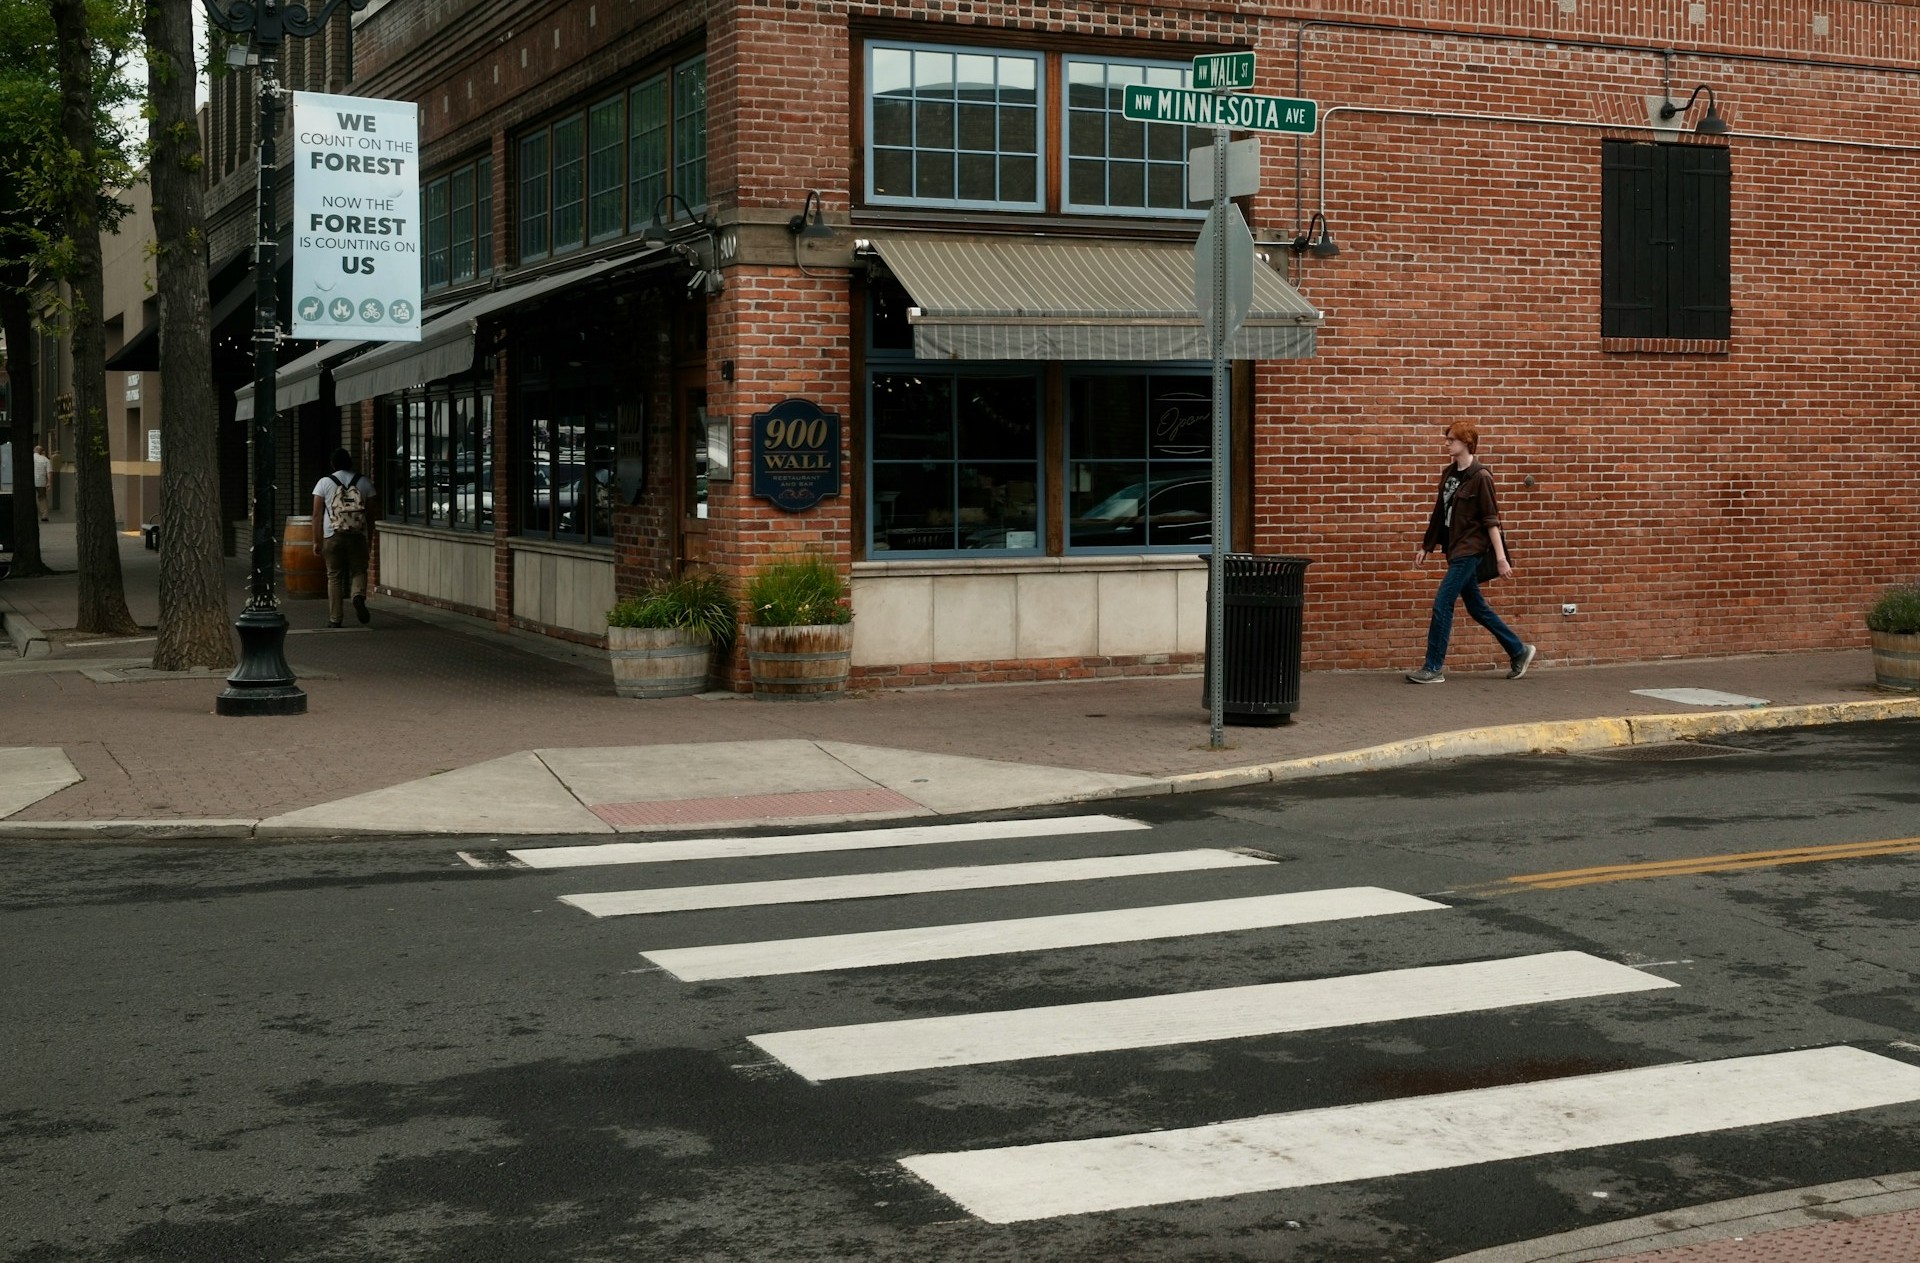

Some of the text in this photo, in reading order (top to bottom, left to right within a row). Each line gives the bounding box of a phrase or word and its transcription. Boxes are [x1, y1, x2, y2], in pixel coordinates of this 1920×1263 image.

[1198, 57, 1249, 86] NW WALL ST
[1135, 90, 1306, 128] NW MINNESOTA AVE
[336, 112, 376, 133] WE
[300, 132, 413, 153] COUNT ON THE
[311, 151, 405, 176] FOREST
[322, 195, 395, 212] NOW THE
[310, 213, 406, 236] FOREST
[299, 236, 415, 253] IS COUNTING ON
[342, 256, 375, 275] US
[764, 418, 828, 449] 900
[1156, 406, 1211, 441] Open
[763, 454, 832, 469] WALL
